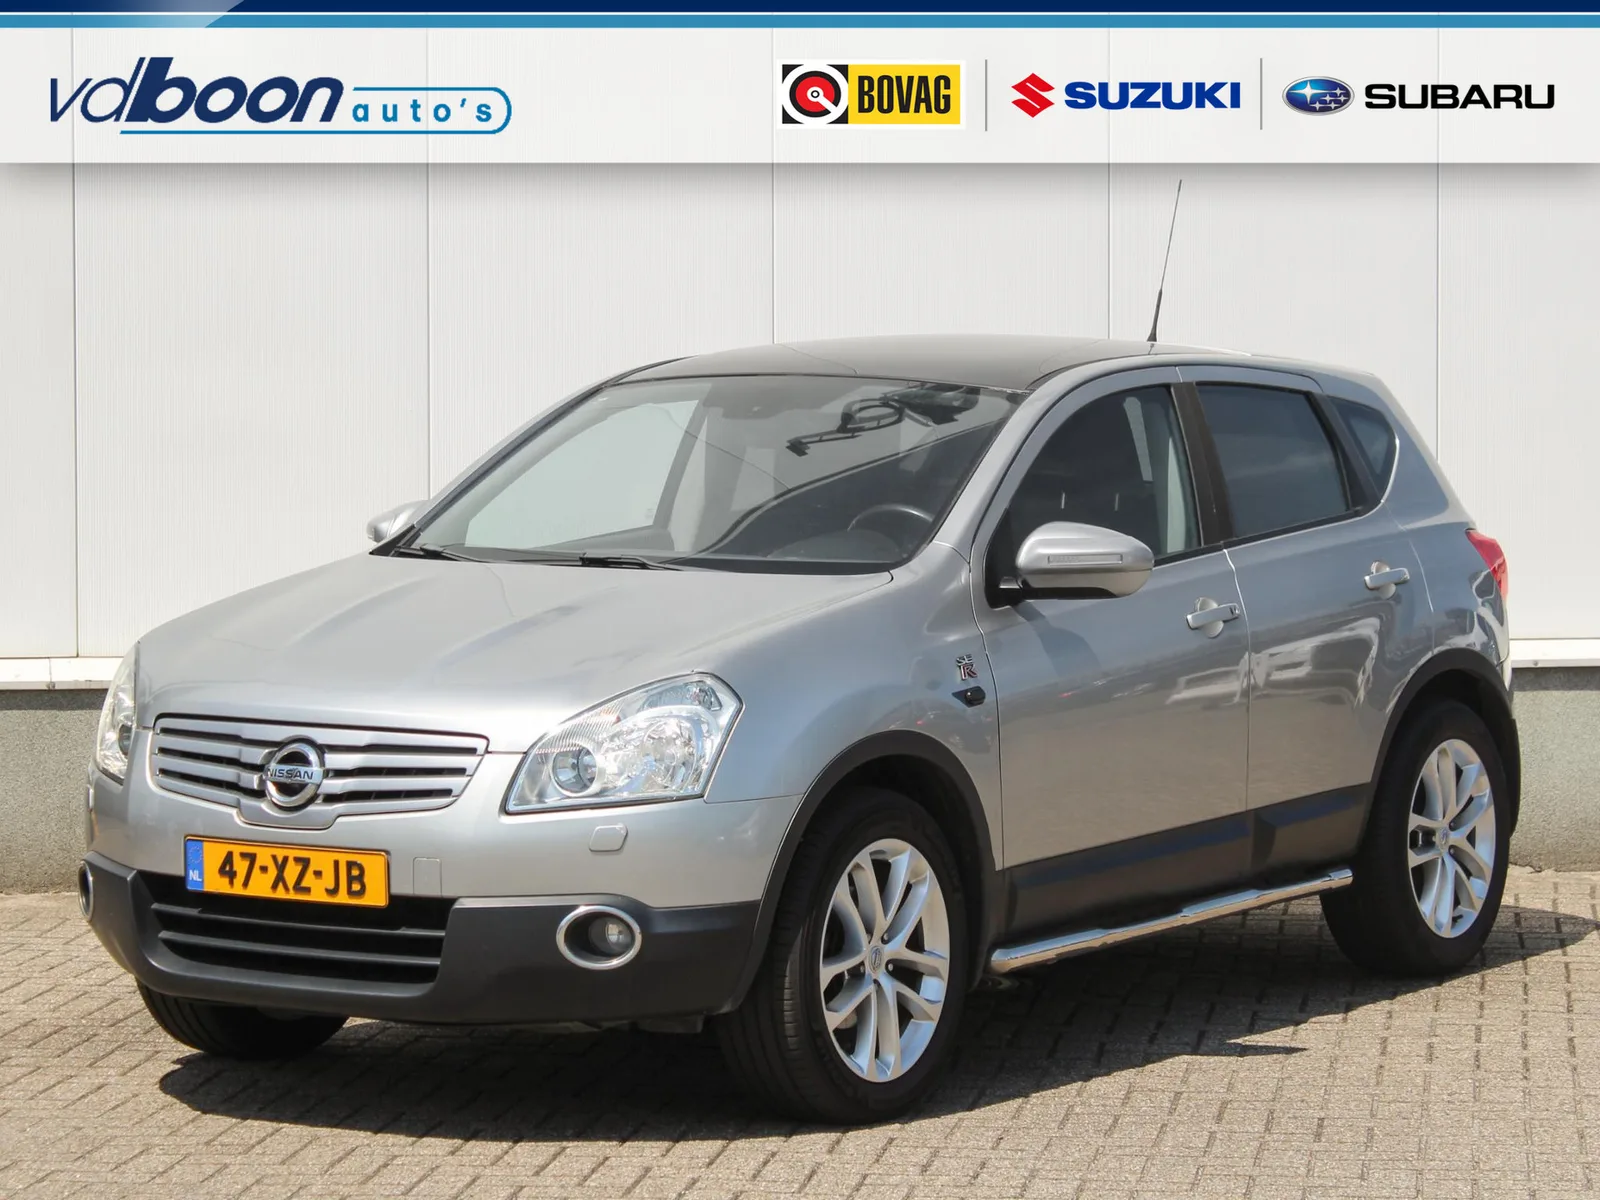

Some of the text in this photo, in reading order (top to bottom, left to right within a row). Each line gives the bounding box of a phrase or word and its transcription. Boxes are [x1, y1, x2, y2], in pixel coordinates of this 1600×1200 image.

[266, 767, 314, 781] NISSAN
[189, 870, 202, 882] NL
[217, 850, 366, 898] 47-XZ-JB
